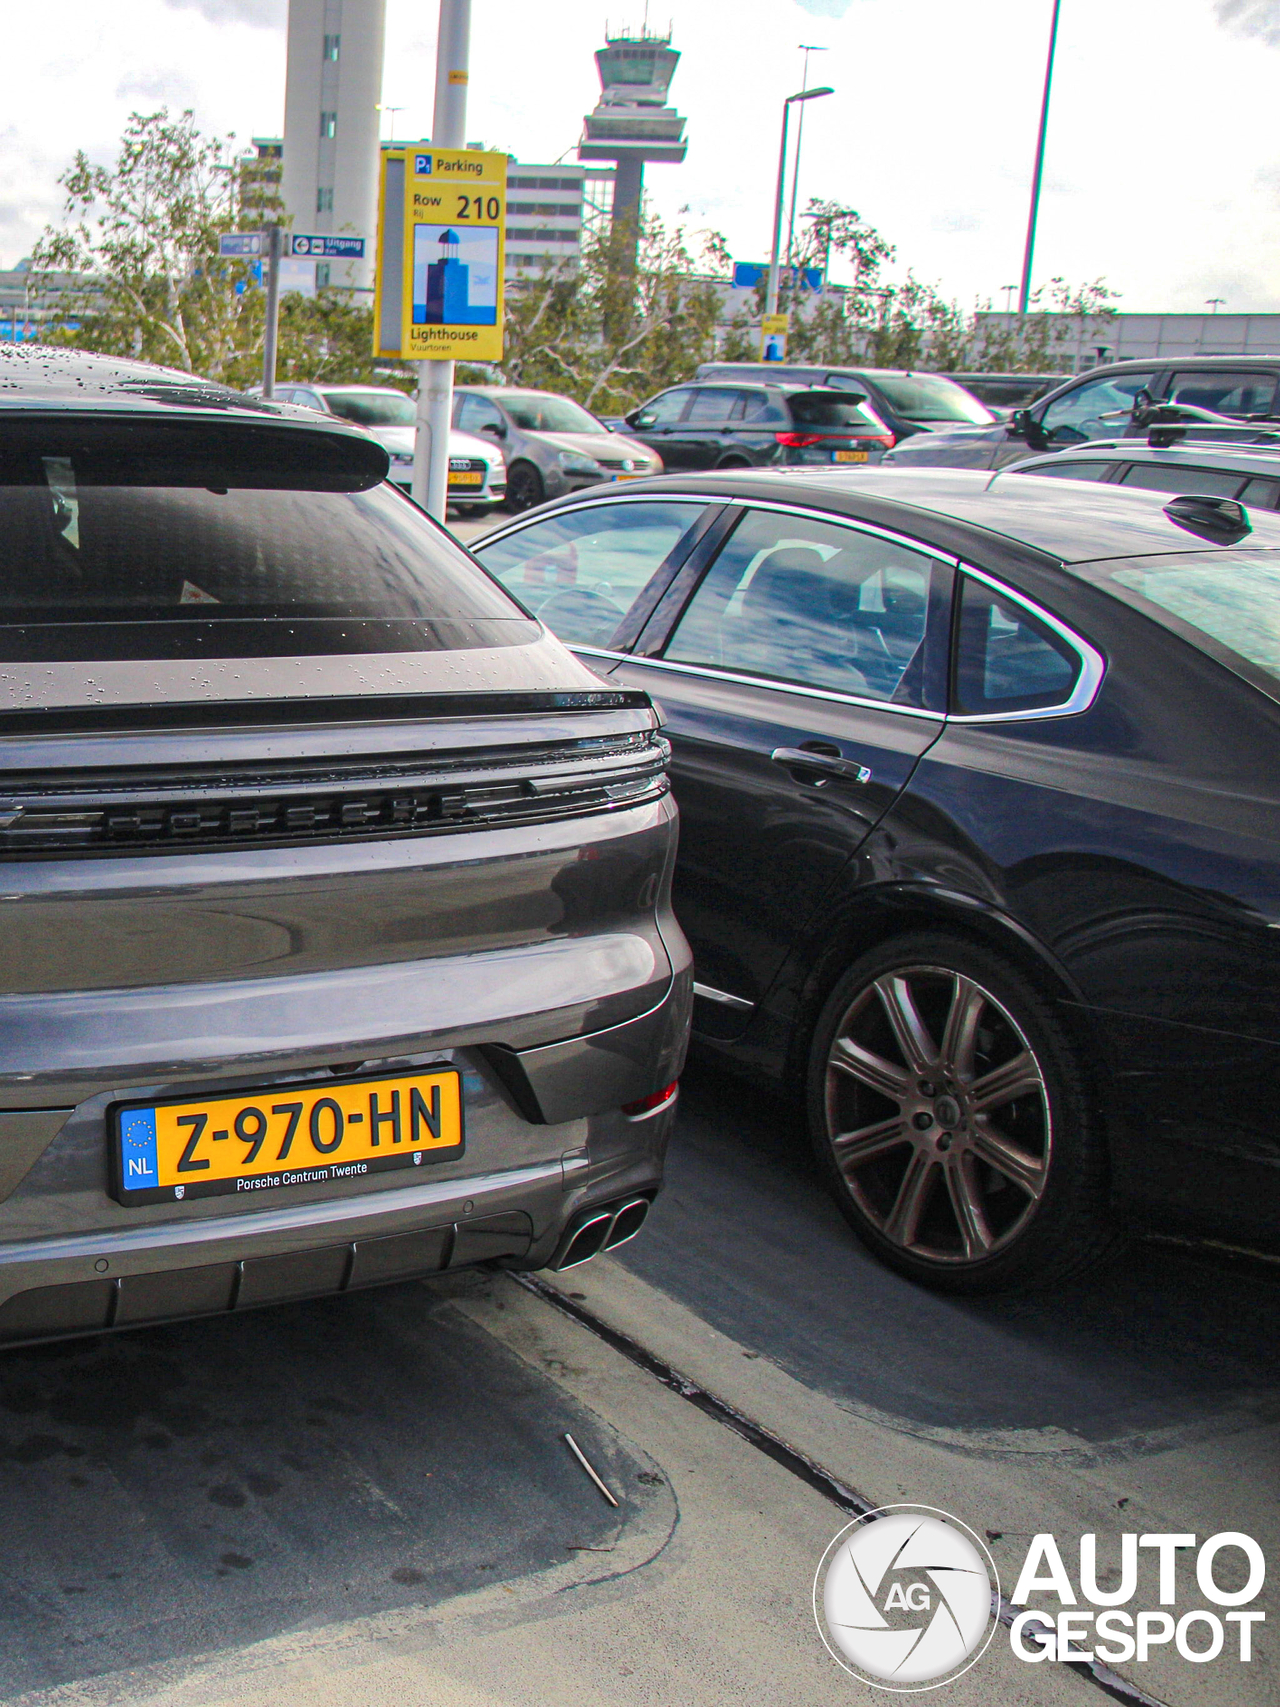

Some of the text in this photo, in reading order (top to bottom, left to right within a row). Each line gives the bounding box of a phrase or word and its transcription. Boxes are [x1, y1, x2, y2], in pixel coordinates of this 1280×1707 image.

[436, 159, 483, 176] Parking
[413, 193, 500, 220] Row 210
[413, 209, 424, 219] Rij
[326, 238, 362, 250] Uitgang
[411, 328, 478, 343] Lighthouse
[411, 343, 451, 352] Vuurtoren
[176, 1084, 442, 1173] Z-970-HN
[128, 1157, 153, 1177] NL
[236, 1163, 368, 1191] Porsche Centrum Twente
